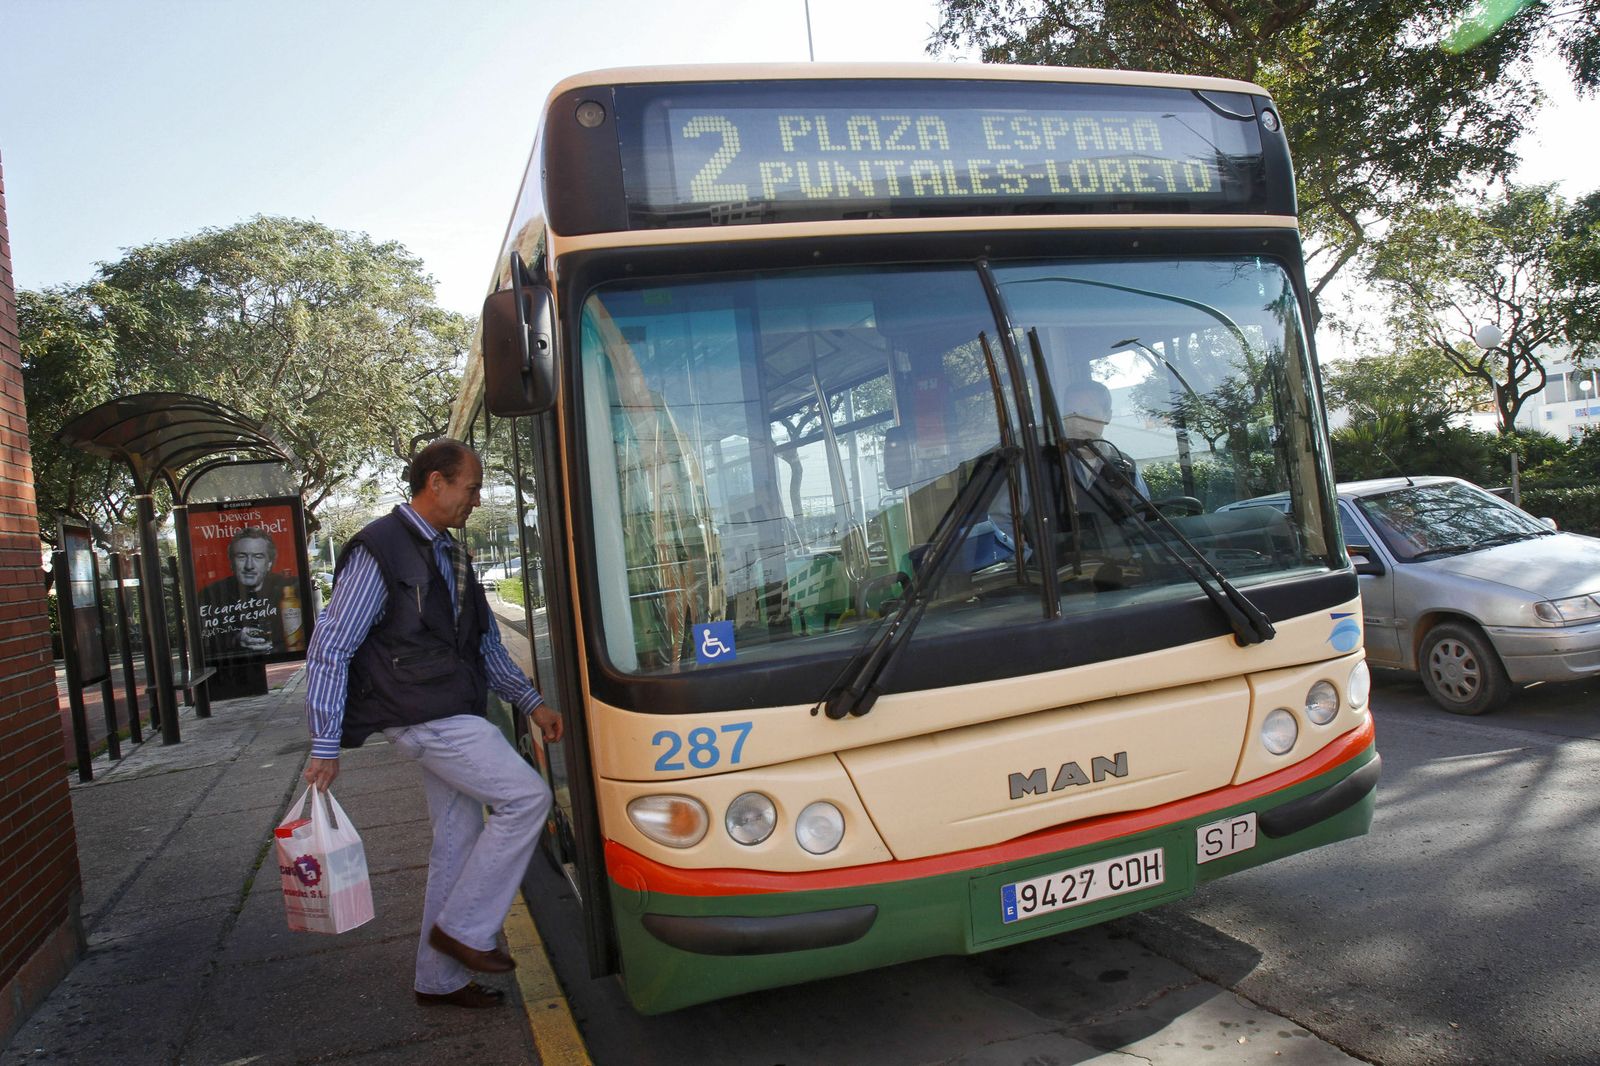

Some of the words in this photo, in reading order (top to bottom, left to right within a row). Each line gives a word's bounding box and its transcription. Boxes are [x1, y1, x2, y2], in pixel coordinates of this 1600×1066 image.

[778, 115, 950, 151] PLAZA
[982, 116, 1163, 151] ESPAÑA
[683, 116, 748, 200] 2
[760, 159, 1213, 199] PUNTALES-LORETO
[219, 511, 261, 523] Dewar's
[200, 604, 212, 617] El
[214, 597, 269, 615] carácter
[205, 617, 219, 627] no
[222, 615, 236, 624] se
[240, 603, 277, 621] regala
[652, 721, 753, 771] 287
[1008, 751, 1129, 800] MAN
[1020, 868, 1095, 912] 9427
[1107, 853, 1161, 891] CDH
